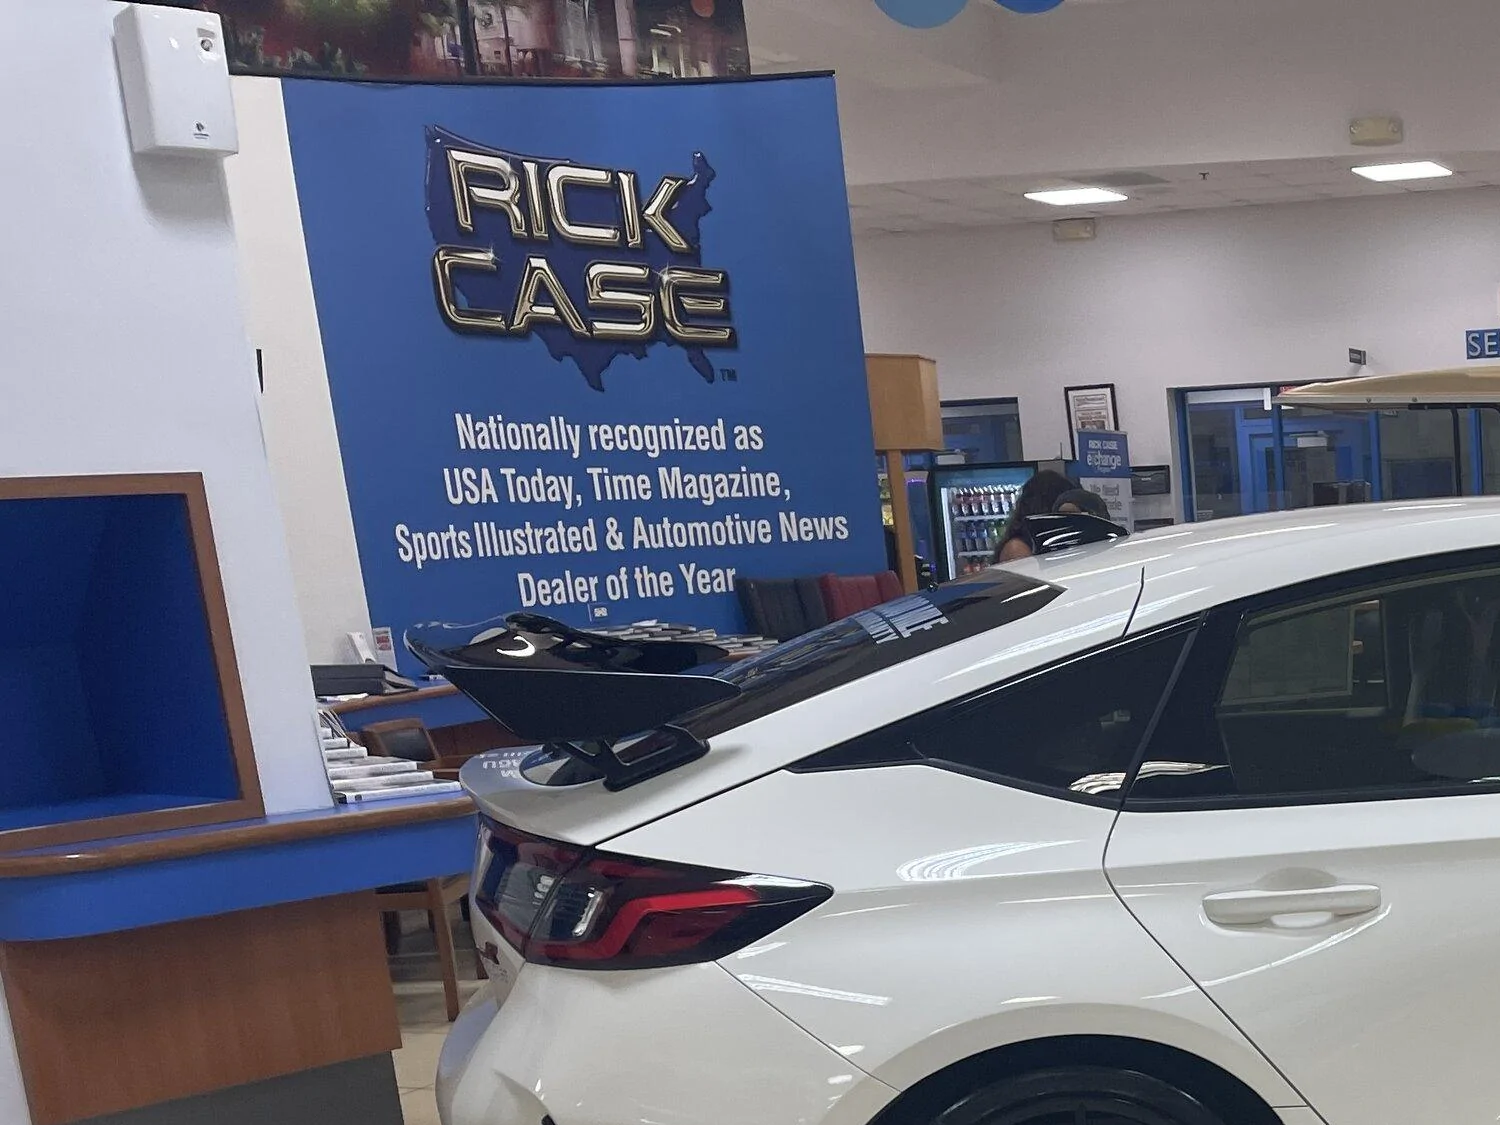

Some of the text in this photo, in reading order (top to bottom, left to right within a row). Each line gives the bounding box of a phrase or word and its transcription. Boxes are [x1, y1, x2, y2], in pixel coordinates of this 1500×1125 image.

[446, 147, 694, 250] RICK
[432, 246, 737, 346] CASE
[455, 413, 764, 459] Nationally recognized as
[443, 466, 791, 510] USA Today, Time Magazine,
[395, 511, 849, 569] Sports Illustrated & Automotive News
[517, 563, 736, 608] Dealer of the Year
